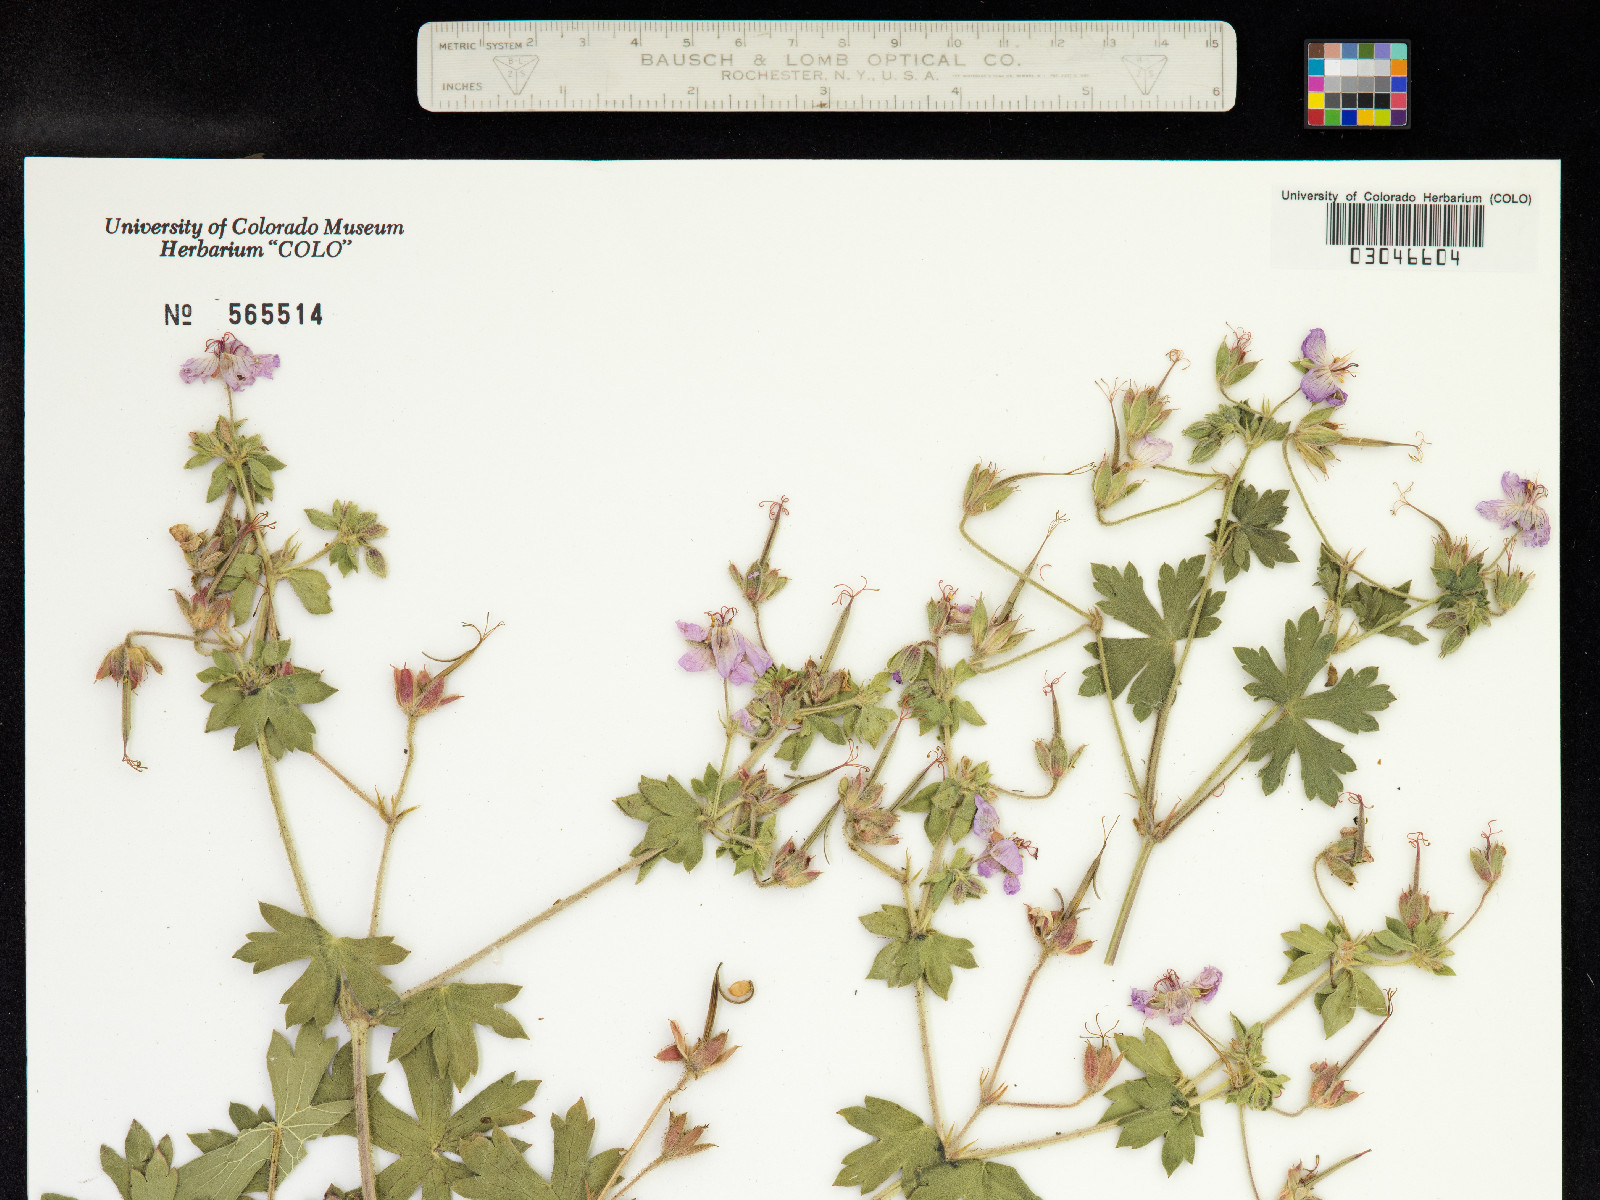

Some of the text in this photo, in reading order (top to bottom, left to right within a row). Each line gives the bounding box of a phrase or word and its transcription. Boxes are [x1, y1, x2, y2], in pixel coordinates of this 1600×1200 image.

[438, 42, 523, 50] METRIC SYSTEM
[641, 53, 1022, 66] BAUSCH & LOMB OPTICAL CO.
[442, 82, 483, 91] INCHES
[1281, 190, 1532, 206] University of Colorado Herbarium (COLO)
[106, 217, 404, 239] University of Colorado Museum
[159, 239, 264, 257] Herbarium
[1350, 247, 1459, 266] 03046604
[229, 303, 322, 325] 565514
